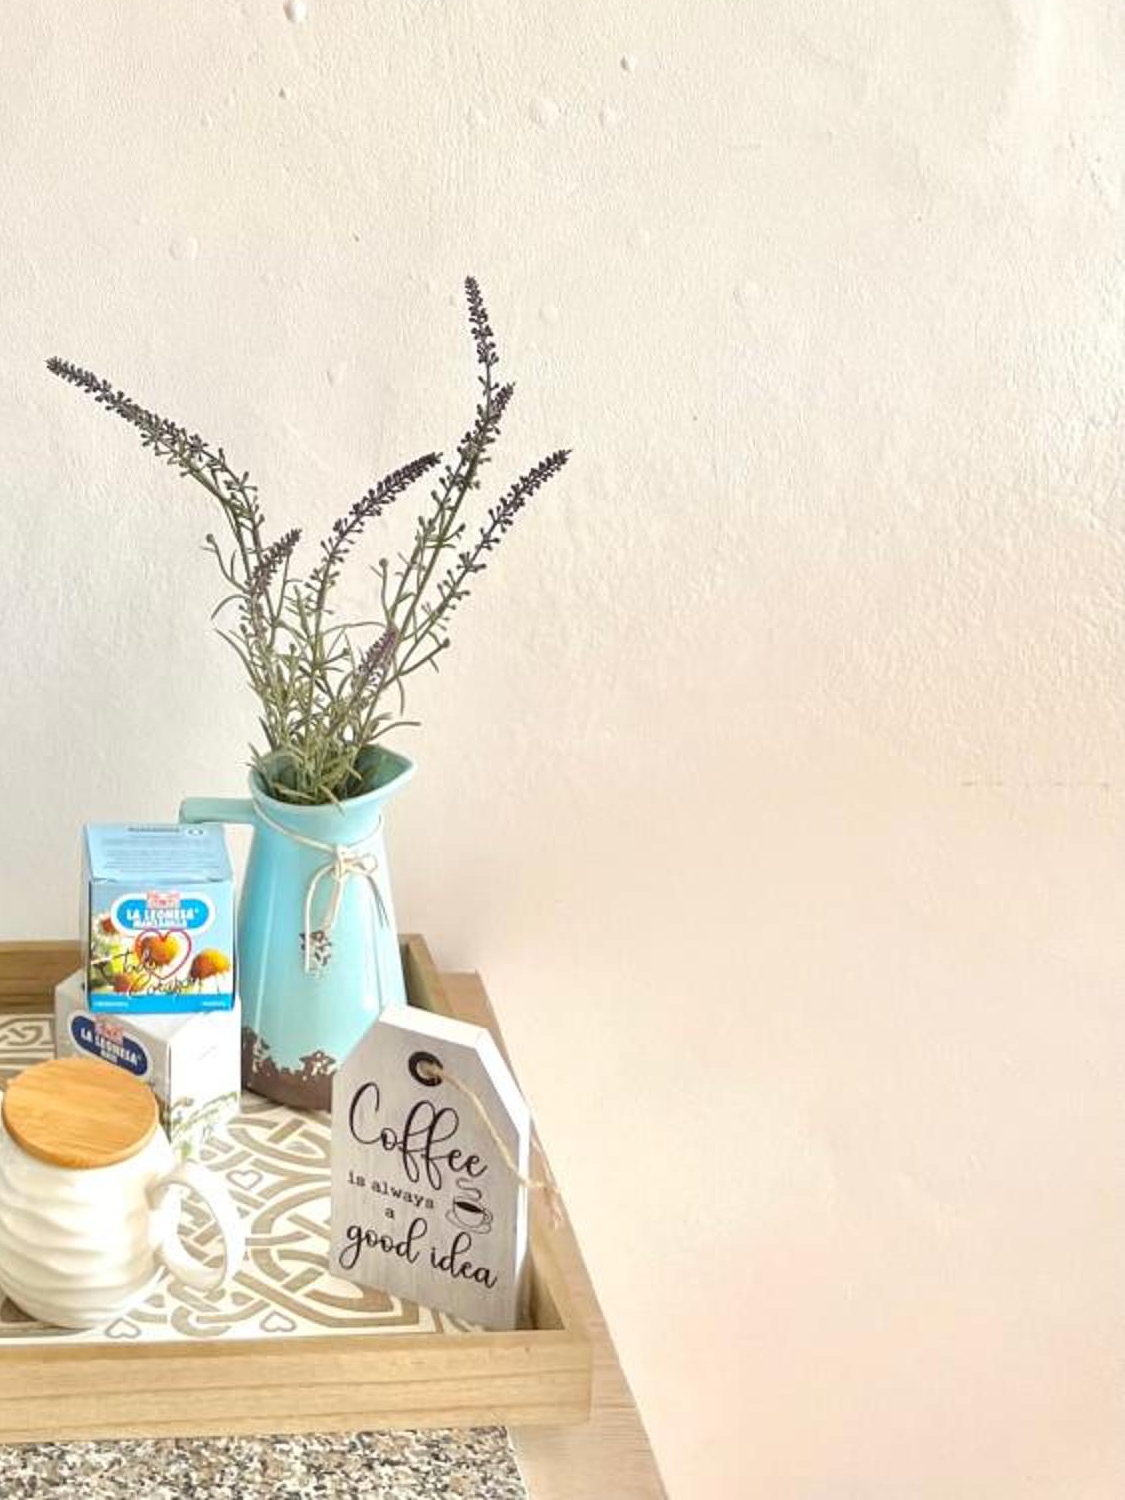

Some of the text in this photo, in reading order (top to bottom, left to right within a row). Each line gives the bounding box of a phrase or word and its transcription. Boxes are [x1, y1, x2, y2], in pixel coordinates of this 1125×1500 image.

[126, 908, 140, 920] LA
[80, 1027, 93, 1043] LA
[349, 1082, 487, 1190] Coffee
[348, 1172, 434, 1209] is always
[384, 1207, 395, 1219] a
[339, 1218, 497, 1288] good idea
